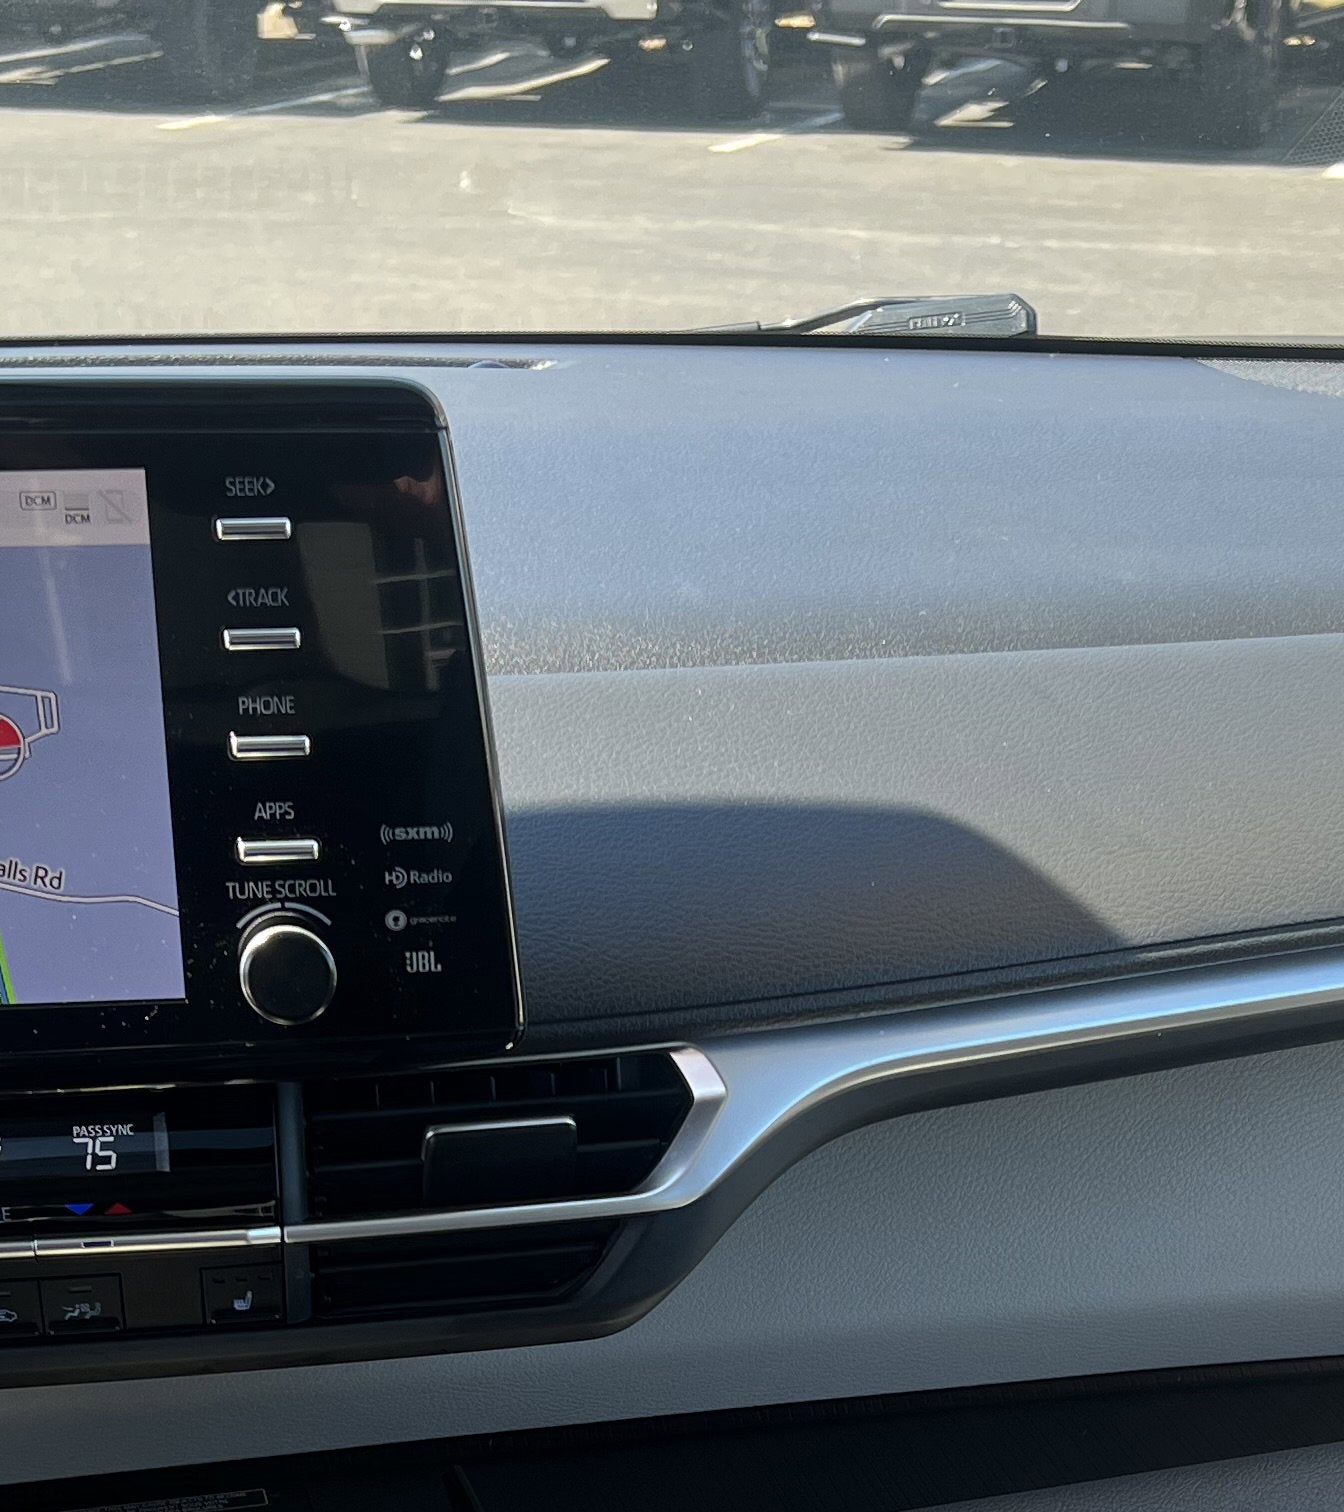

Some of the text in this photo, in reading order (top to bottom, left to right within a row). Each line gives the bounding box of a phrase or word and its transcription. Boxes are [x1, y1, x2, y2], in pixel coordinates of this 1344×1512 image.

[64, 514, 91, 525] DCM
[238, 696, 296, 715] PHONE
[254, 802, 295, 820] APPS
[33, 865, 64, 890] Rd
[409, 869, 453, 885] Radio
[225, 879, 337, 899] TUNE SCROLL
[405, 950, 443, 974] JBL
[72, 1122, 135, 1139] PASS SYNC
[72, 1136, 118, 1172] 75
